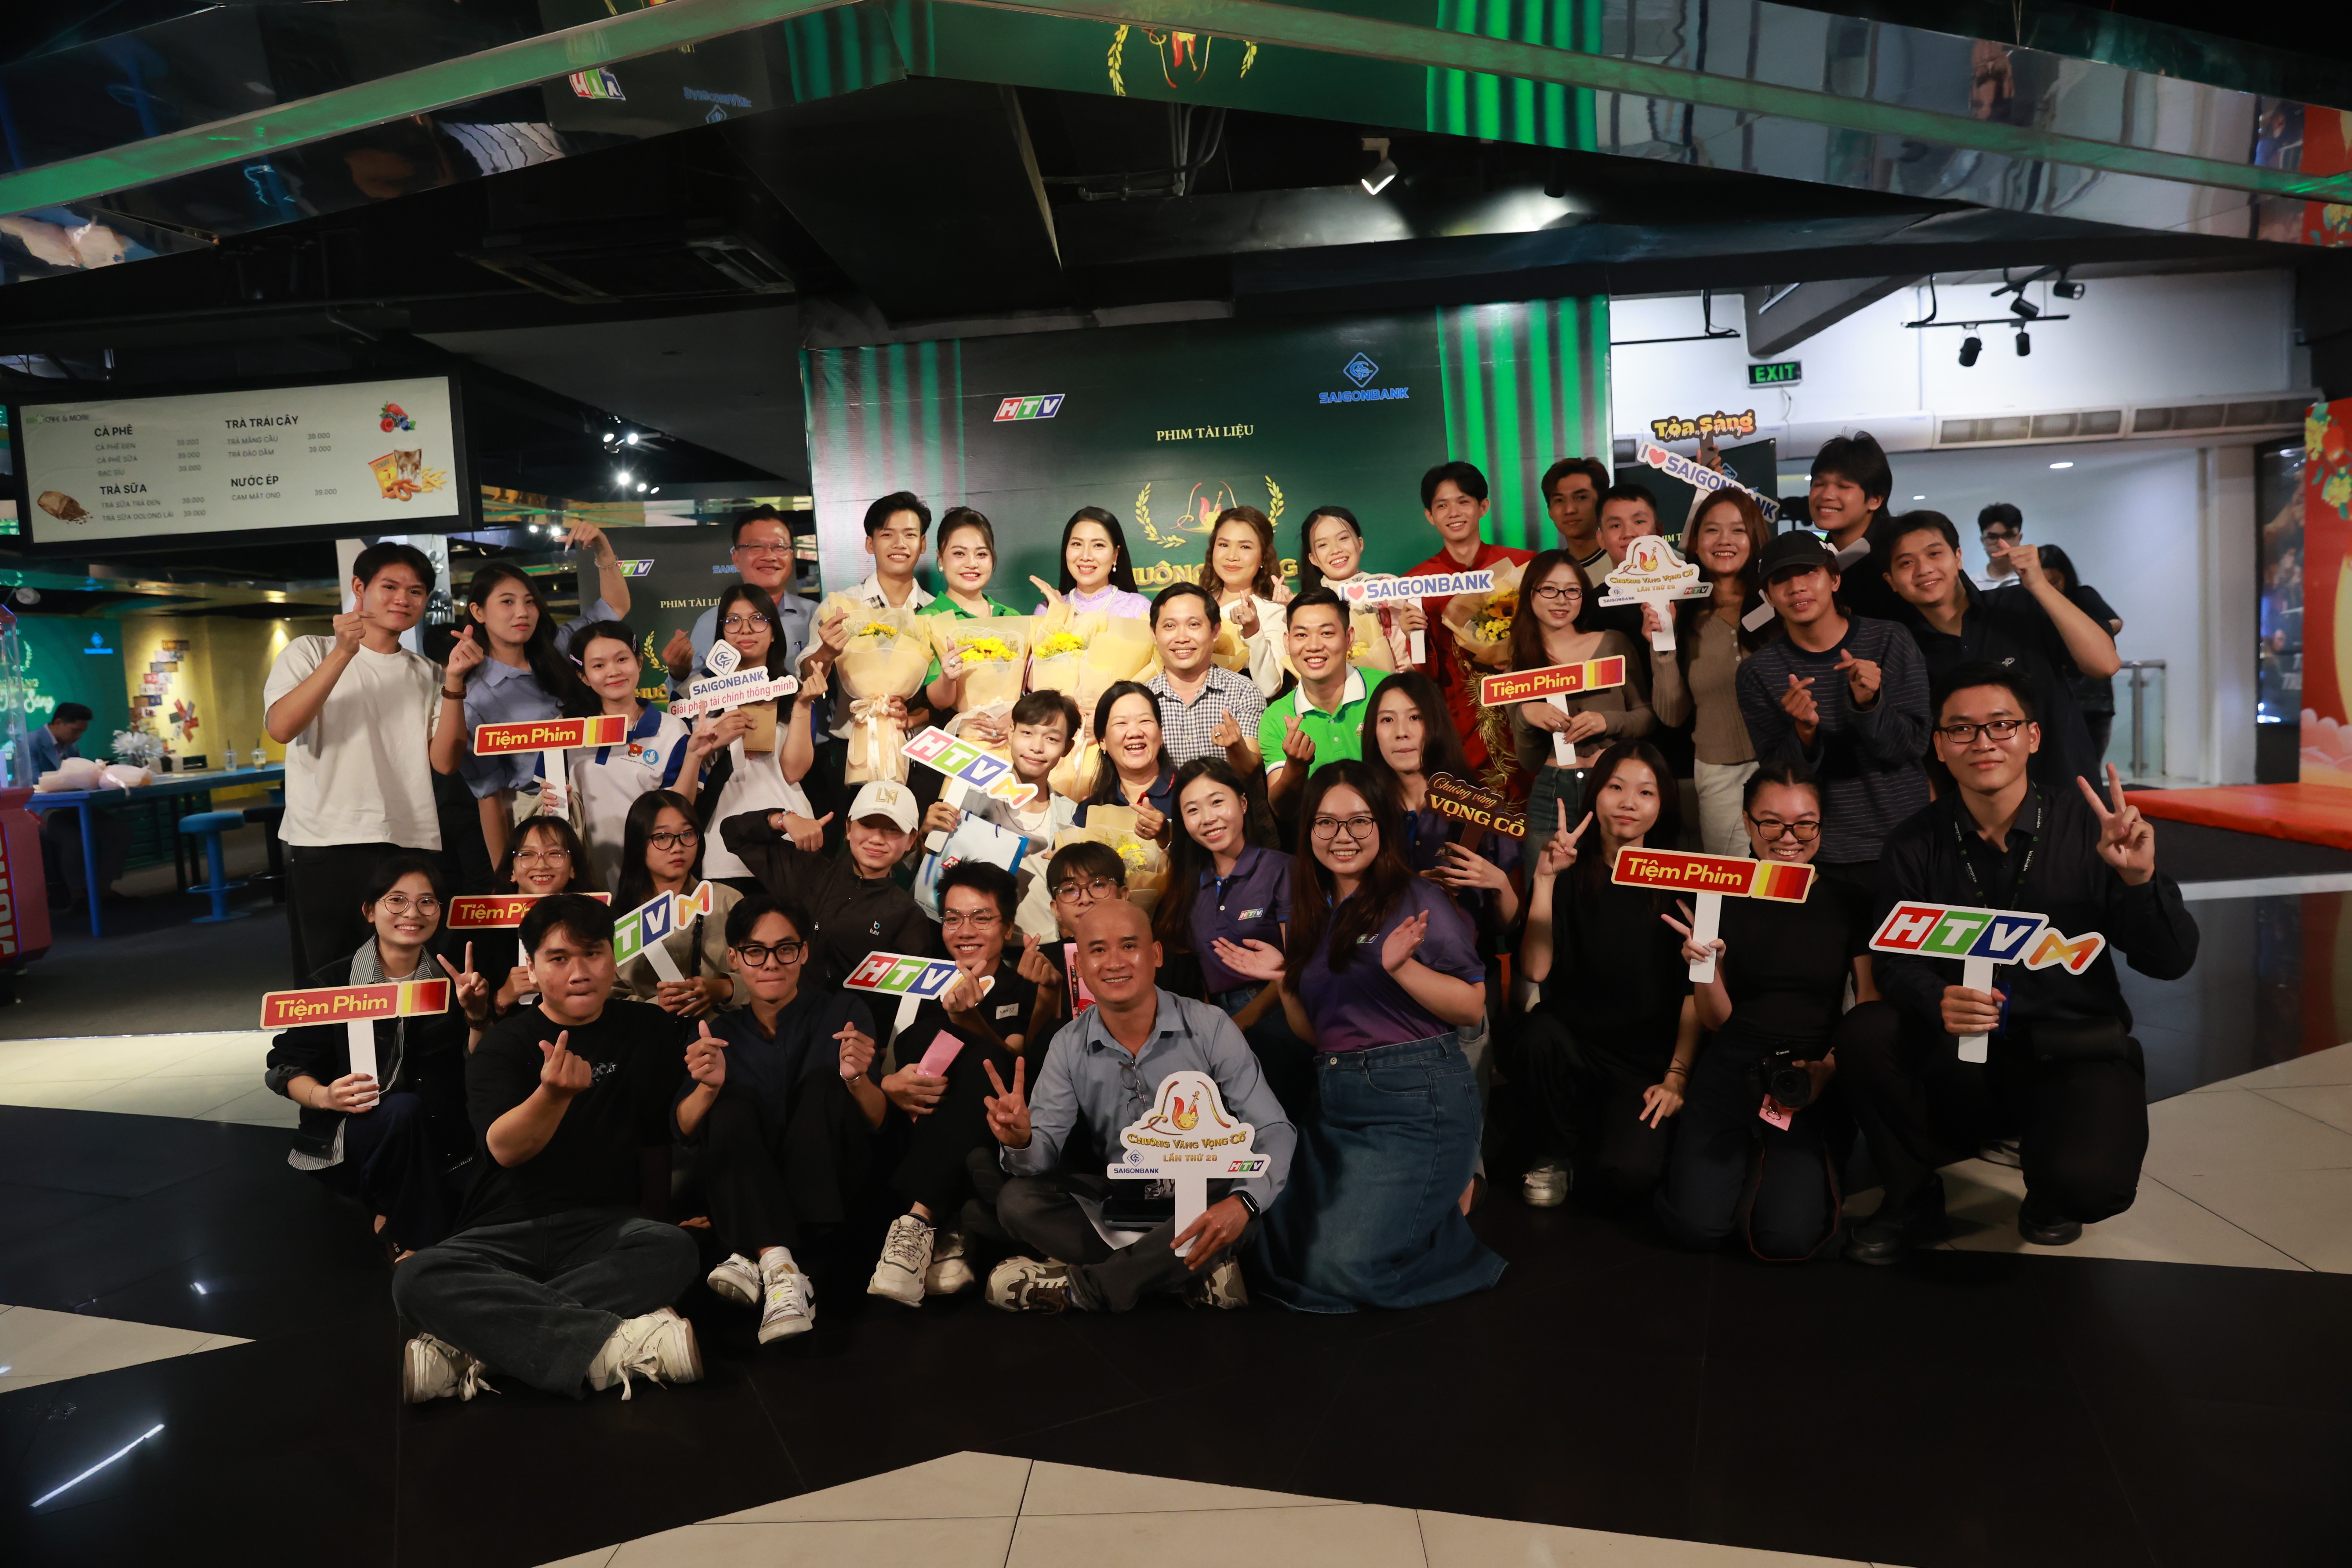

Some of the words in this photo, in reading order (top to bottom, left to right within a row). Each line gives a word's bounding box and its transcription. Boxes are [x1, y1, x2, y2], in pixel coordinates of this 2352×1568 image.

[1755, 364, 1795, 382] EXIT
[1319, 387, 1409, 404] SAIGONBANK
[996, 395, 1062, 419] HTV
[94, 426, 110, 437] CÀ
[113, 424, 133, 436] PHÊ
[225, 417, 247, 429] TRÀ
[249, 416, 274, 428] TRÁI
[276, 414, 299, 426] CÂY
[1654, 419, 1695, 437] Tỏa
[1699, 412, 1753, 433] Sáng
[1156, 429, 1193, 441] PHIM
[1196, 425, 1220, 438] TÀI
[1223, 423, 1254, 438] LIỆU
[309, 445, 331, 453] 39.000
[100, 483, 122, 495] TRÀ
[123, 482, 147, 494] SỮA
[231, 475, 263, 487] NƯỚC
[314, 488, 338, 496] 39.000
[1367, 573, 1491, 599] SAIGONBANK
[660, 600, 686, 609] PHIM
[688, 598, 706, 607] TÀI
[693, 670, 765, 696] SAIGONBANK
[1490, 680, 1531, 699] Tiệm
[1534, 673, 1576, 691] Phim
[670, 703, 686, 715] Giải
[710, 695, 720, 707] tài
[722, 691, 744, 703] chính
[746, 686, 771, 697] thông
[773, 679, 794, 693] minh
[485, 730, 528, 749] Tiệm
[531, 726, 576, 743] Phim
[1433, 777, 1472, 800] Chuông
[1472, 793, 1498, 809] vàng
[1430, 794, 1491, 826] VỌNG
[1493, 818, 1525, 837] CỔ
[1628, 857, 1681, 882] Tiệm
[1684, 862, 1742, 886] Phim
[459, 902, 505, 924] Tiệm
[1239, 908, 1263, 919] HTV
[274, 1000, 329, 1021] Tiệm
[332, 993, 388, 1013] Phim
[1127, 1133, 1170, 1148] CHUÔNG
[1172, 1140, 1199, 1149] VÀNG
[1201, 1138, 1228, 1150] VỌNG
[1163, 1152, 1182, 1162] LẦN
[1185, 1153, 1204, 1161] THỨ
[1229, 1161, 1263, 1171] HTV
